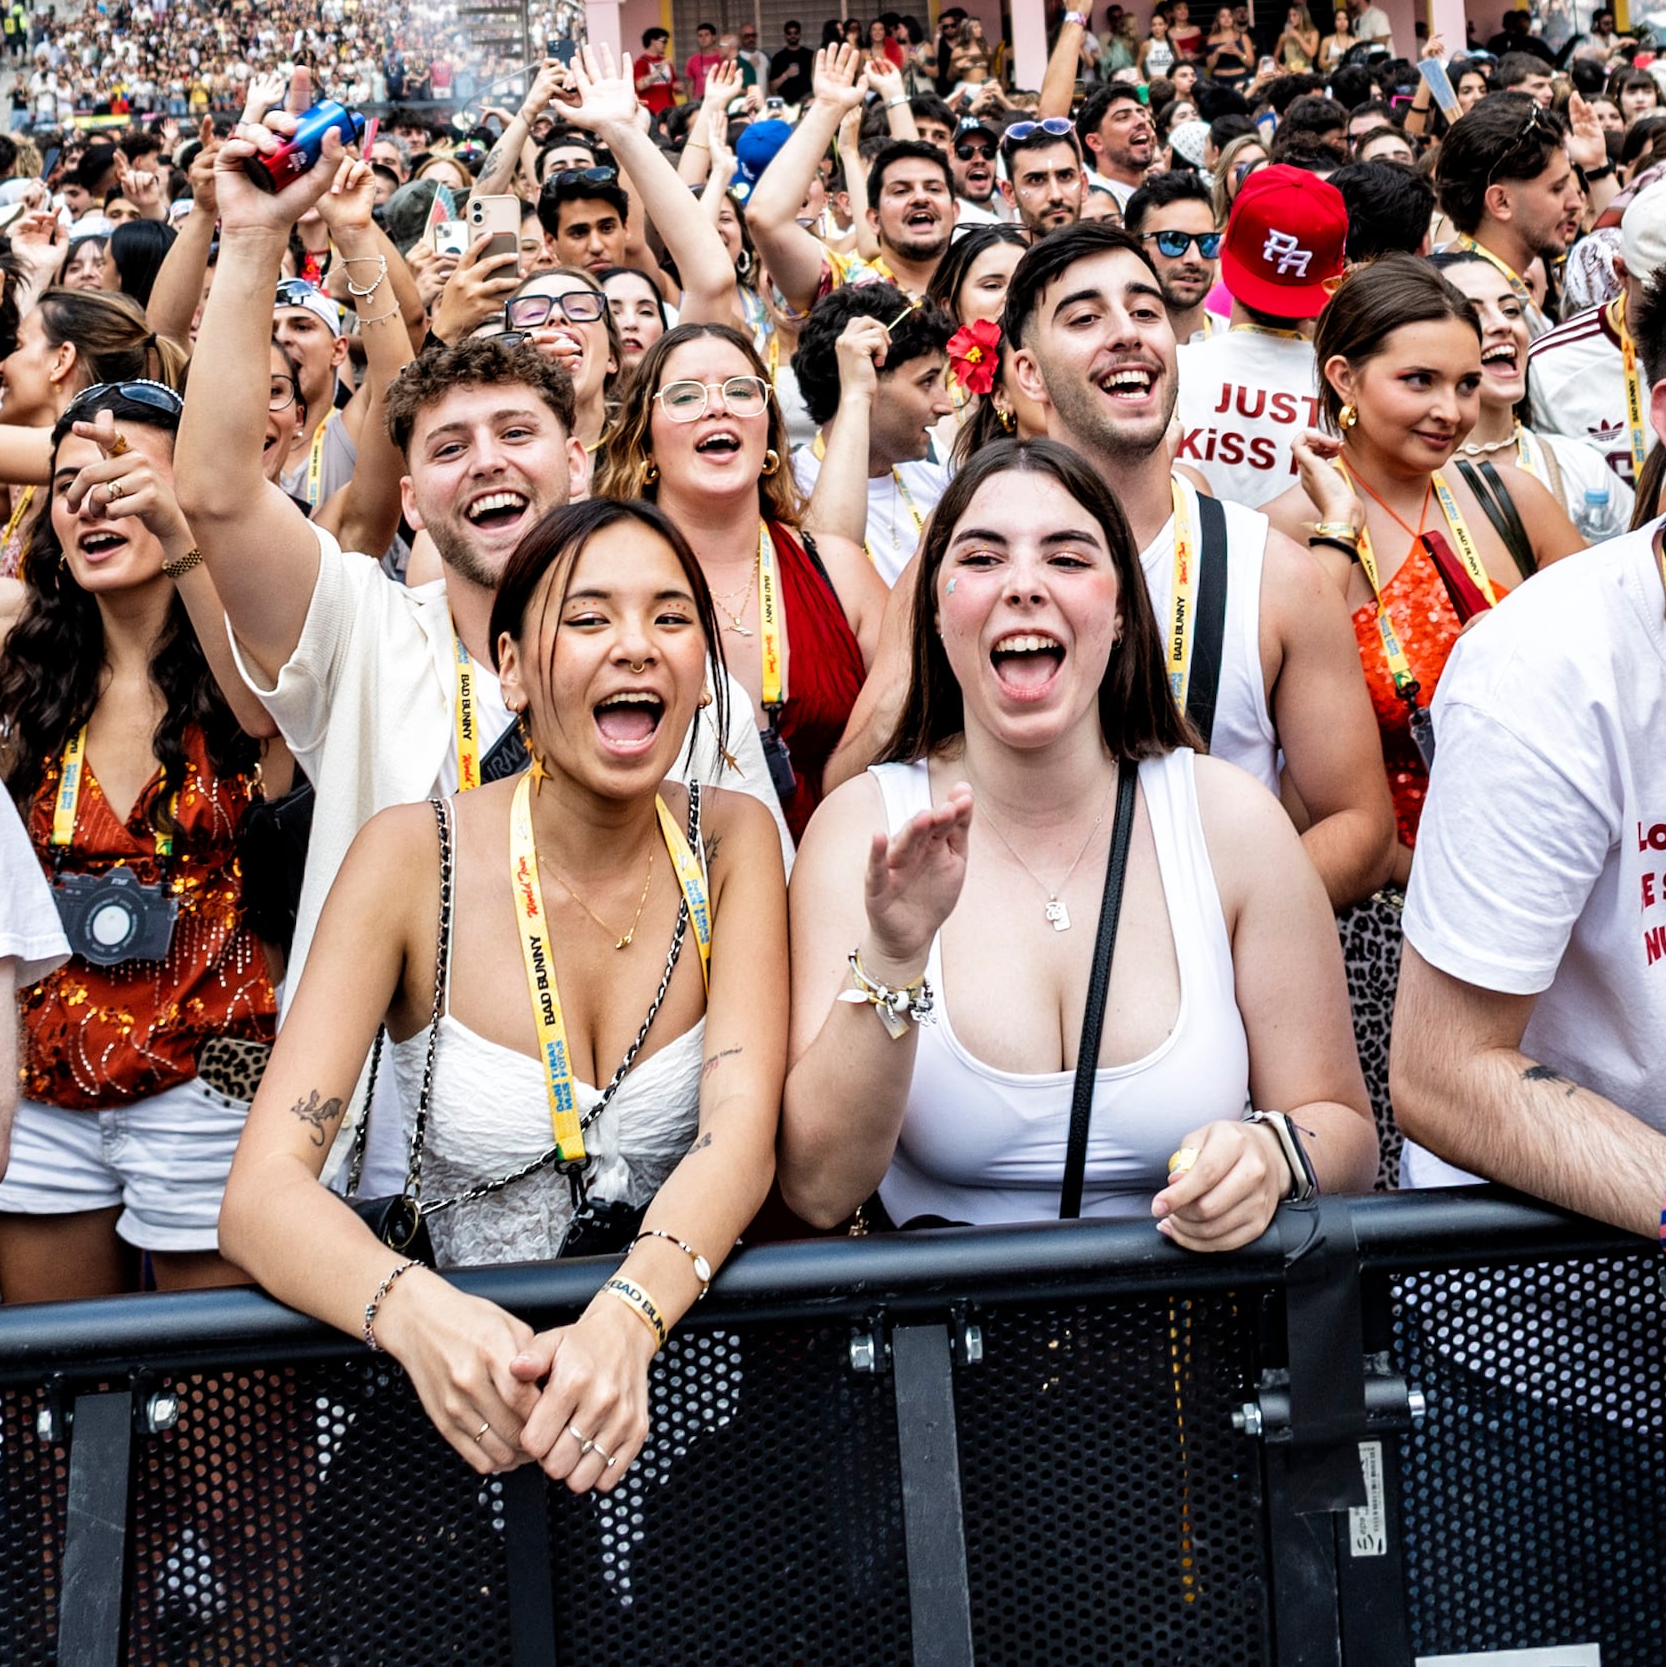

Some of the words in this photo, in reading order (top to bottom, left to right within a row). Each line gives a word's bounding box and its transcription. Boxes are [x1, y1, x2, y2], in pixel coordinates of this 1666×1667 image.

[1175, 597, 1186, 635] BUNNY
[1174, 638, 1183, 661] BAD
[461, 674, 470, 696] BAD
[462, 699, 472, 741] BUNNY
[517, 856, 531, 882] Tour
[521, 883, 539, 918] World
[529, 935, 550, 990] BUNNY
[537, 991, 556, 1026] BAD
[610, 1279, 642, 1302] BAD
